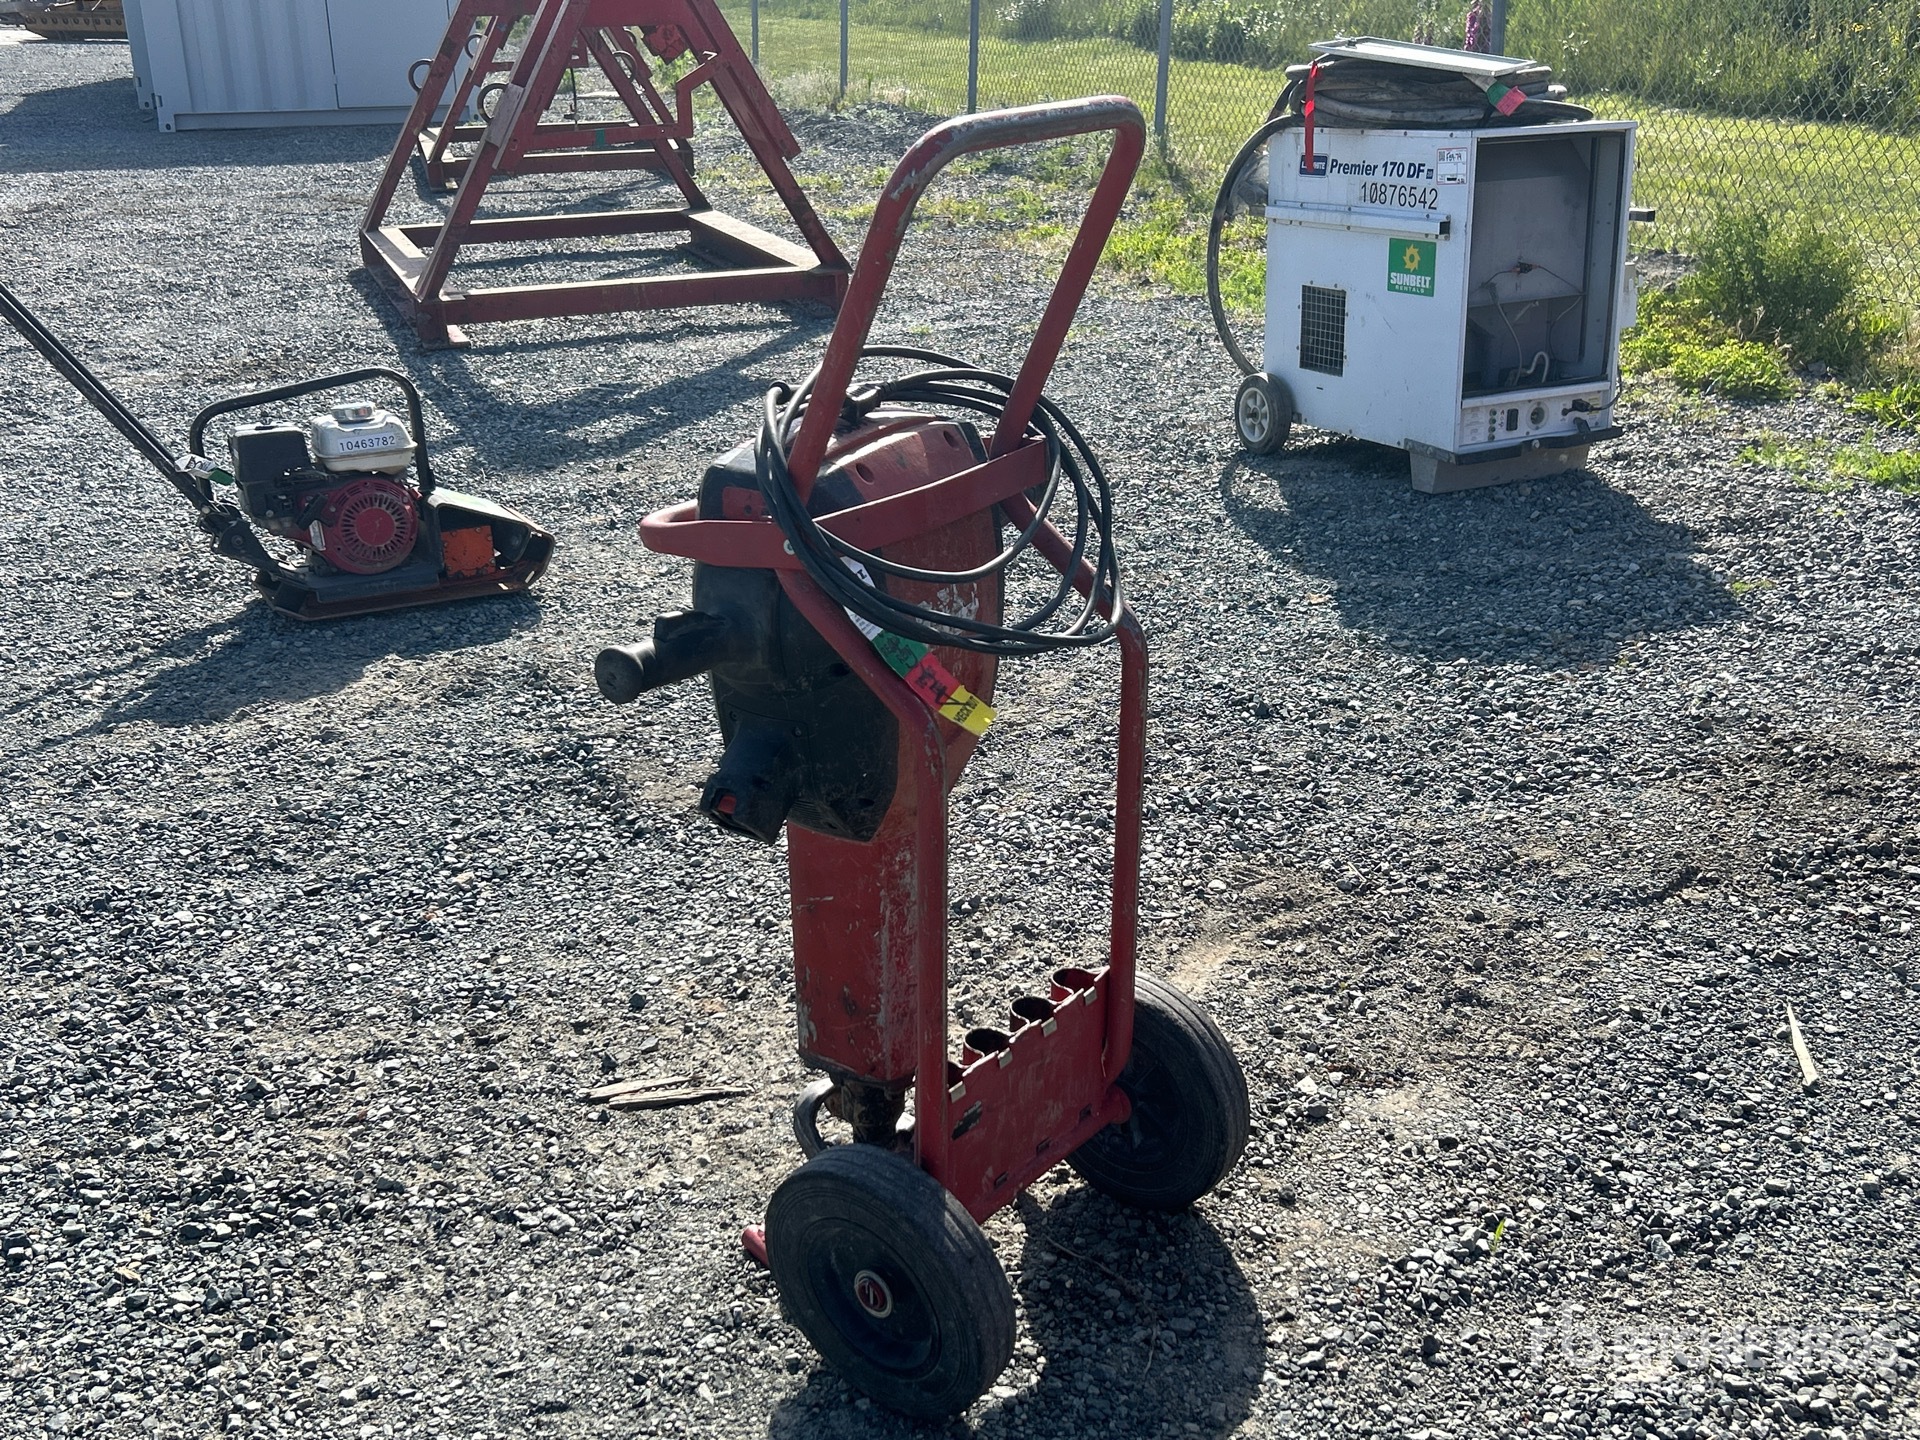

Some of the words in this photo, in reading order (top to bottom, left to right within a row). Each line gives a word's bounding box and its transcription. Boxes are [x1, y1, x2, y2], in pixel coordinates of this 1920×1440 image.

[1330, 158, 1378, 176] Premier
[1381, 161, 1405, 177] 170
[1407, 162, 1426, 179] DF
[1361, 181, 1438, 210] 10876542
[1390, 272, 1431, 288] SUNBELT
[1395, 284, 1425, 293] RENTALS
[340, 435, 396, 451] 10463782
